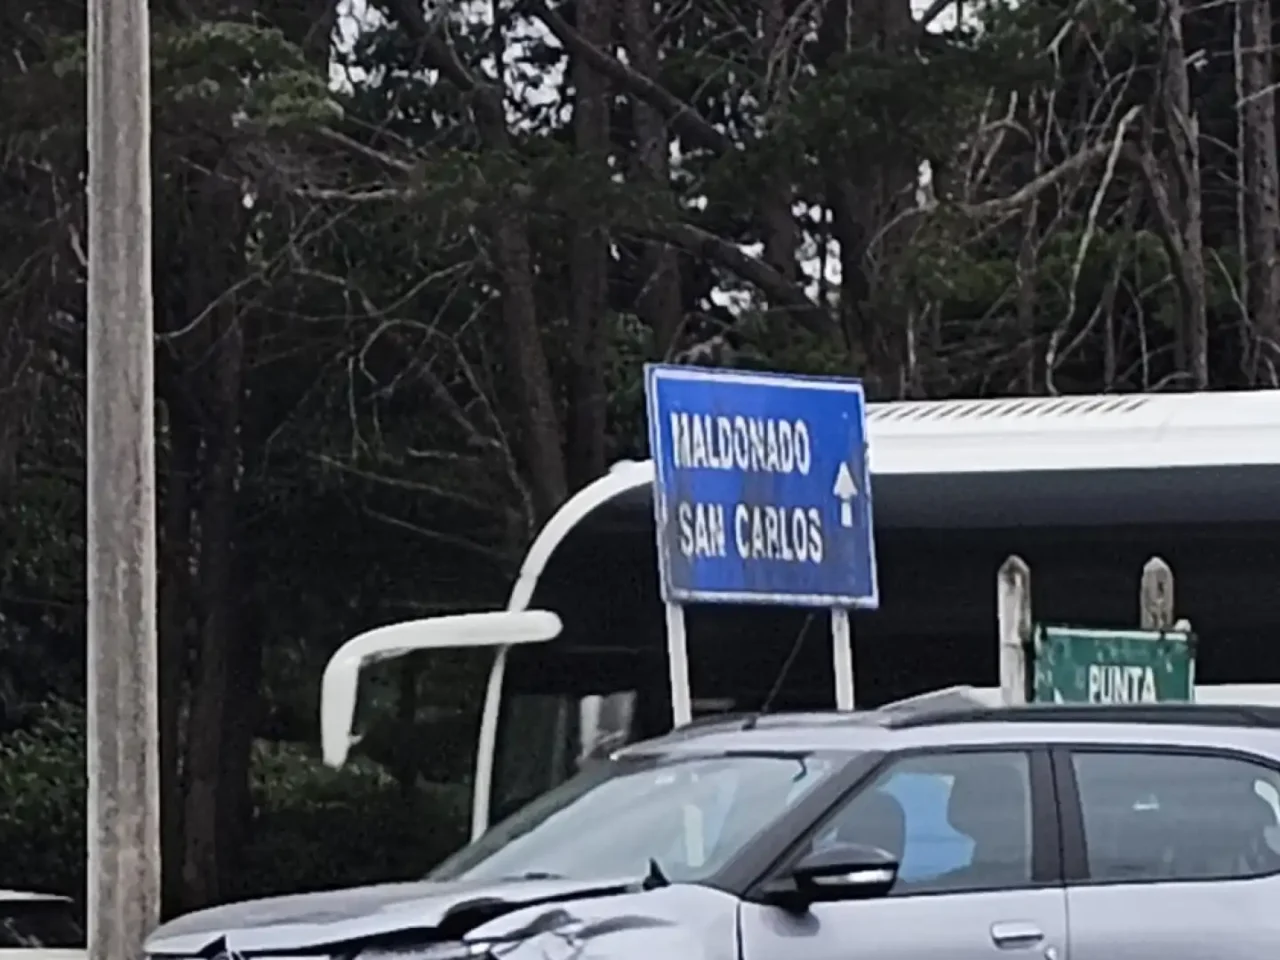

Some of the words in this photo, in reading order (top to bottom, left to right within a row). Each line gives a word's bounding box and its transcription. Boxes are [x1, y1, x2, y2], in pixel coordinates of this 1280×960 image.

[670, 411, 811, 475] MALDONADO
[678, 501, 727, 558] SAN
[735, 503, 823, 564] CARLOS
[1088, 663, 1158, 704] PUNTA
